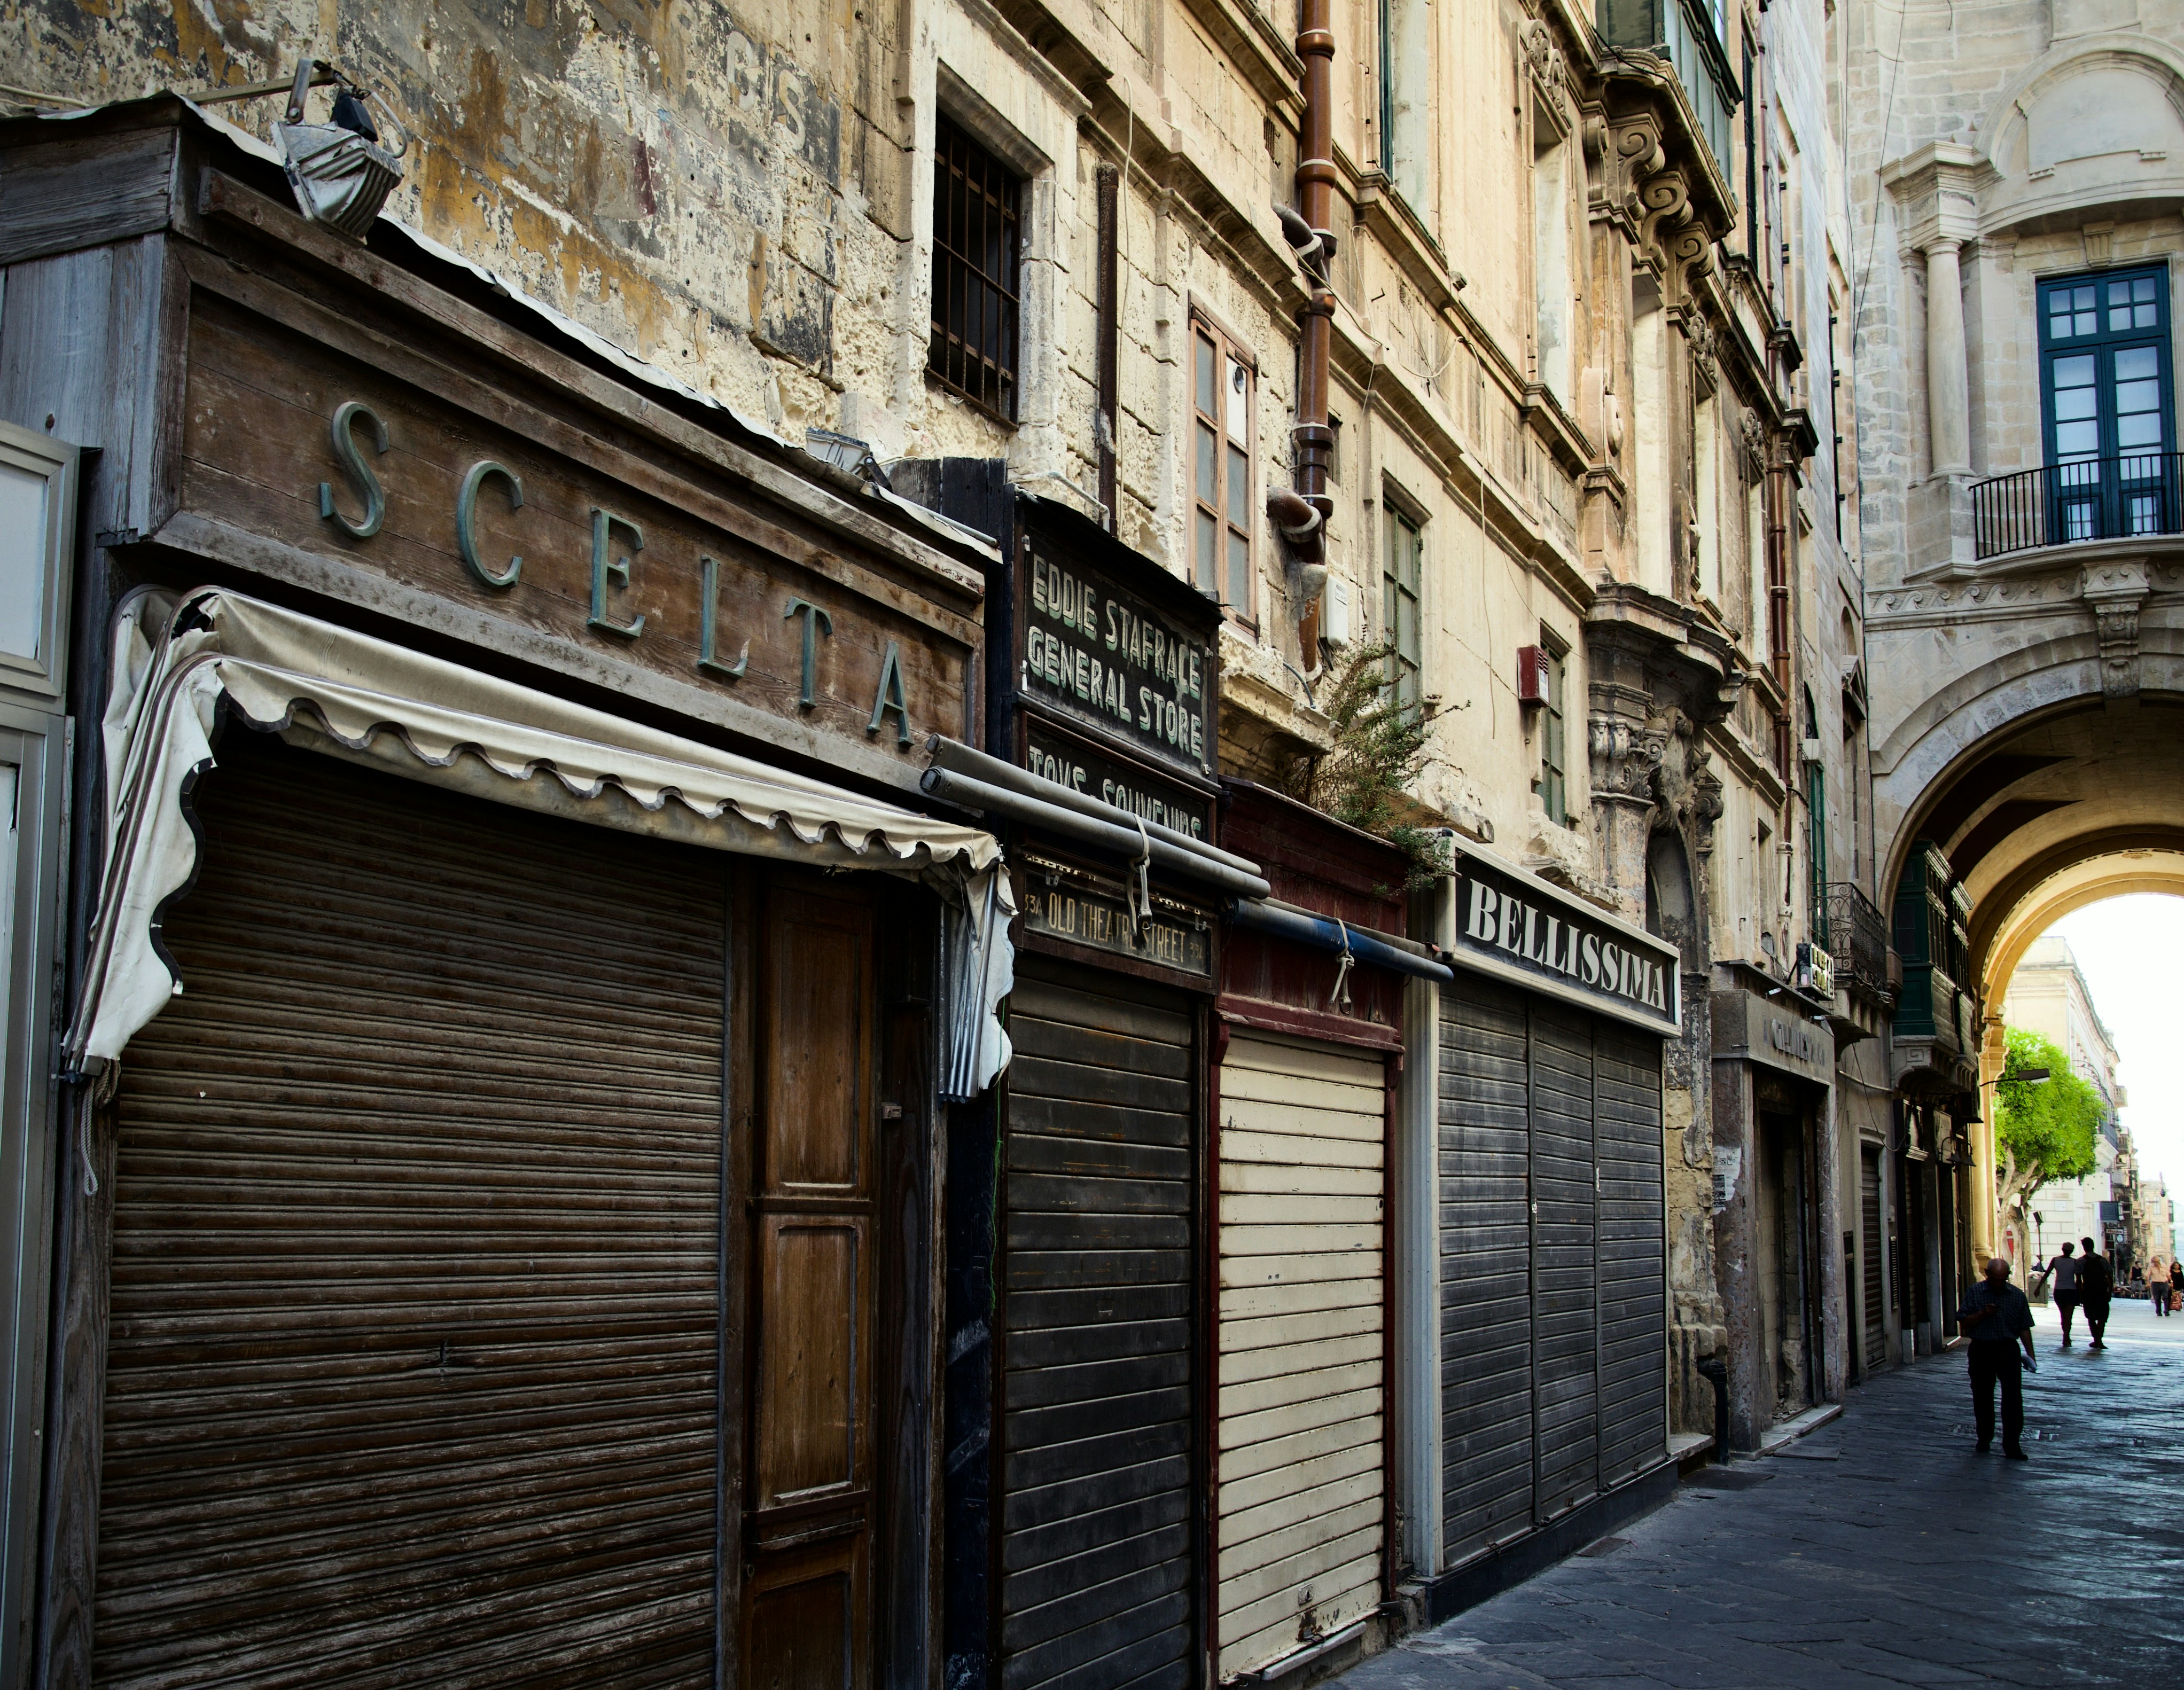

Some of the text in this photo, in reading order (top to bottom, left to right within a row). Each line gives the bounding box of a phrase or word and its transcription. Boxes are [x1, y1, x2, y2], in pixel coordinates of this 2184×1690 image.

[319, 400, 915, 747] SCELTA
[1033, 553, 1200, 701] EDDIE STAFRACE
[1027, 625, 1203, 760] GENERAL STORE
[1049, 892, 1075, 934] OLD
[1465, 878, 1667, 1012] BELLISSIMA
